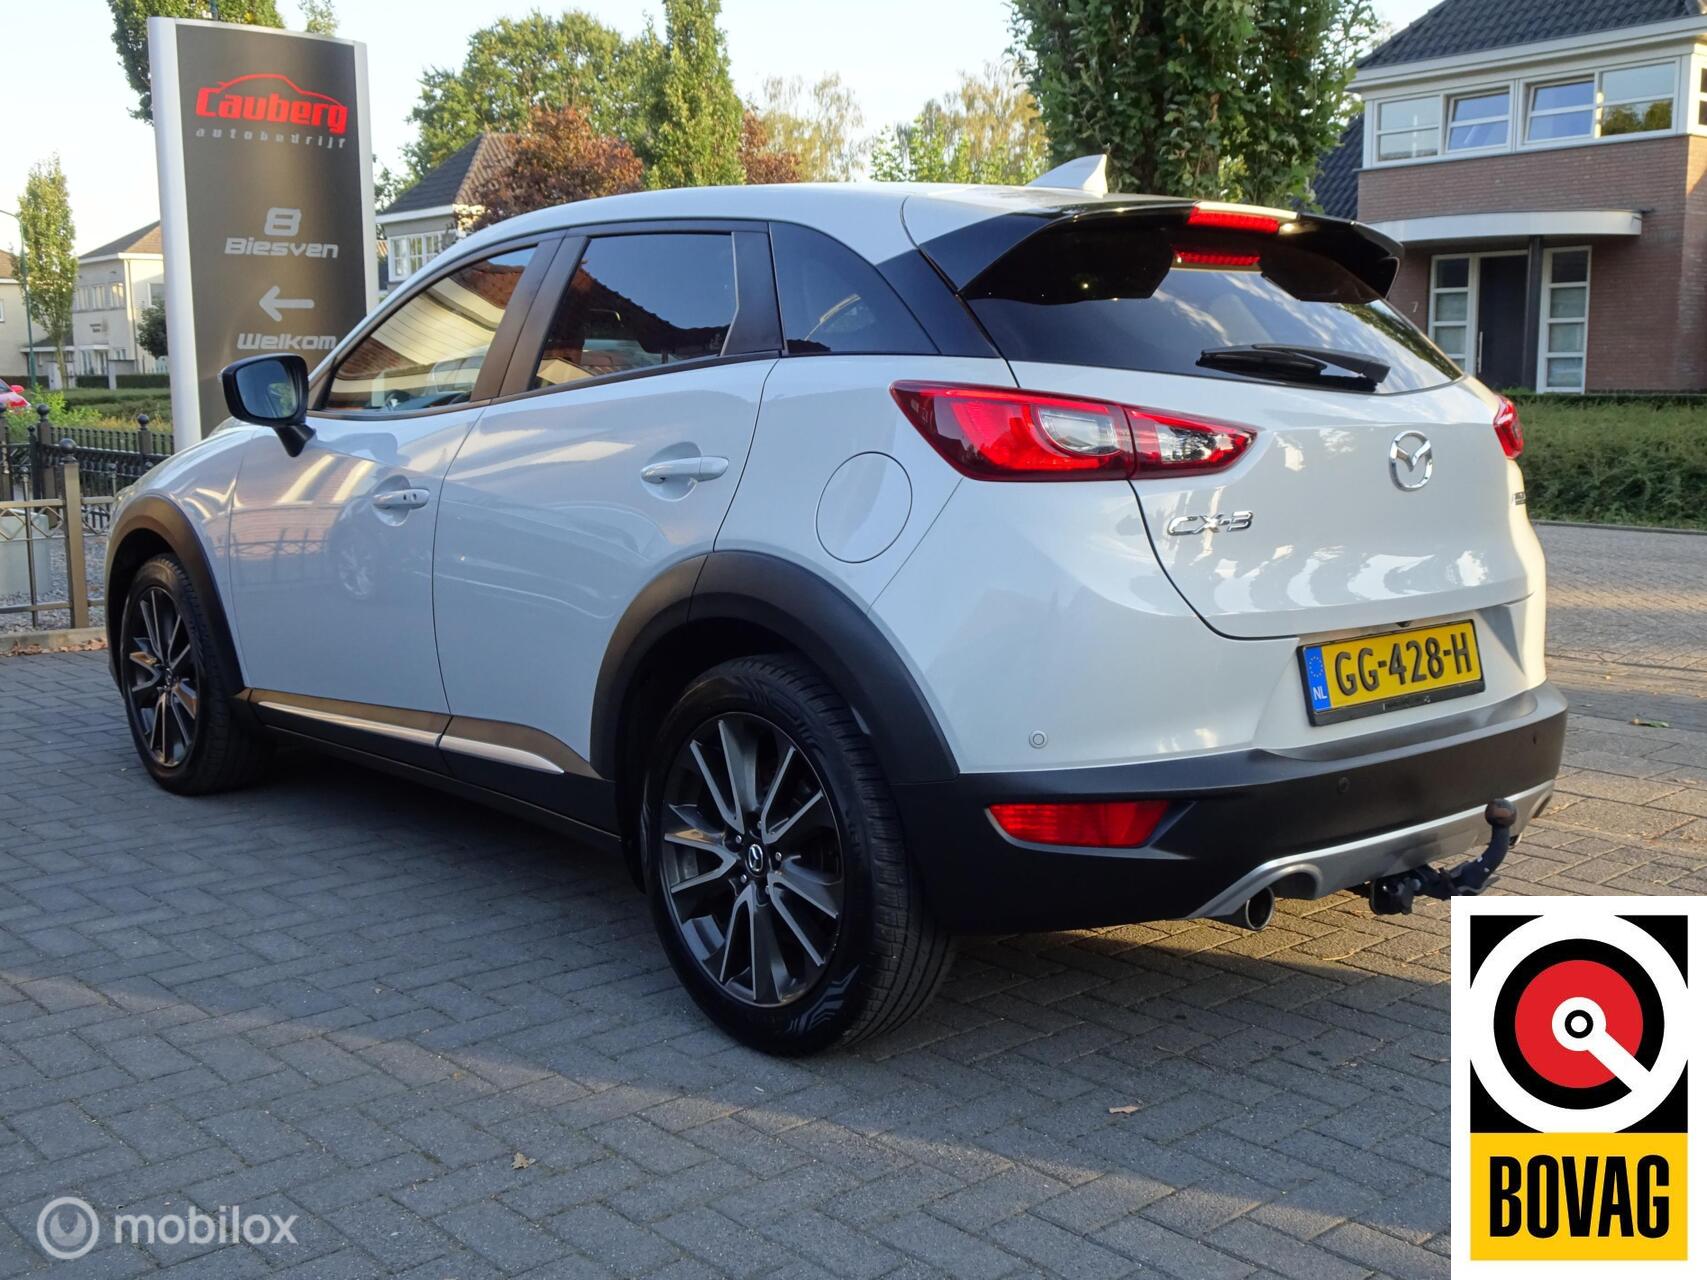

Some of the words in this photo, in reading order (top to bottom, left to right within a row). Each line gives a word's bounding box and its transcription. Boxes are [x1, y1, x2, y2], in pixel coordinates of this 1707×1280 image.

[195, 87, 348, 135] Cauberg
[224, 236, 339, 258] Biesven
[237, 333, 337, 350] Welkom
[1167, 511, 1253, 536] CX-3
[1334, 632, 1473, 696] GG-428-H
[1313, 685, 1328, 700] NL
